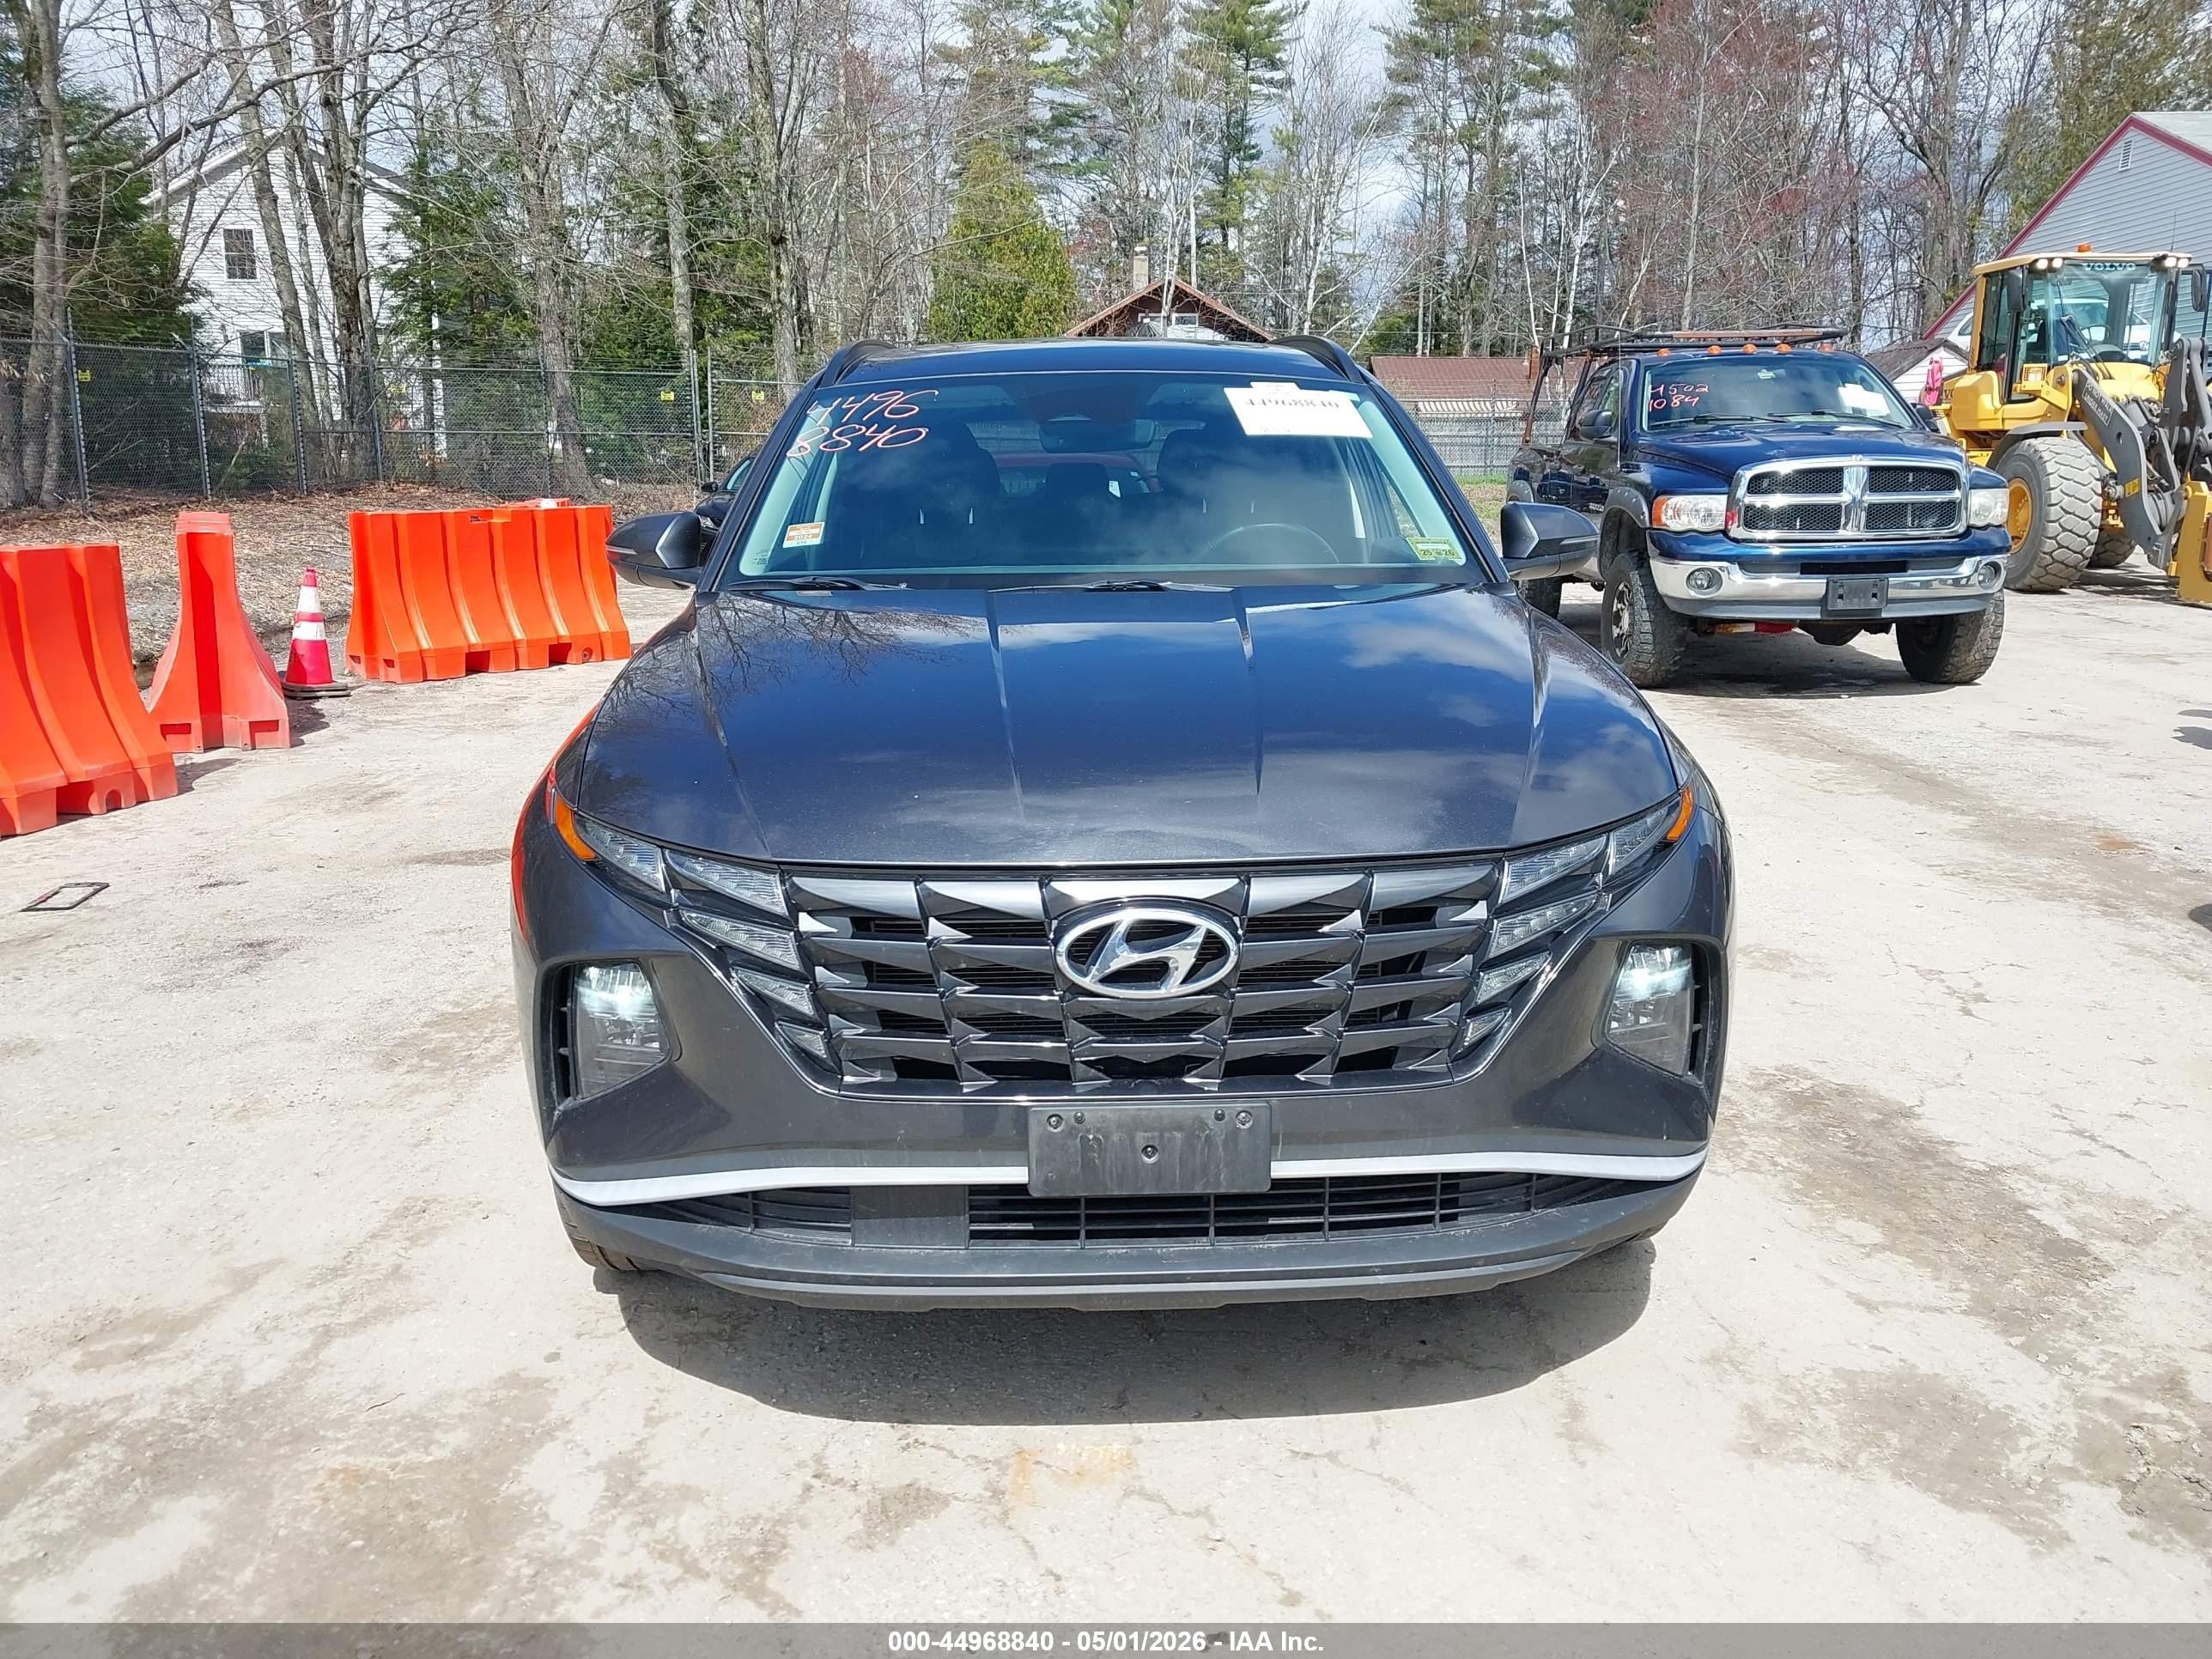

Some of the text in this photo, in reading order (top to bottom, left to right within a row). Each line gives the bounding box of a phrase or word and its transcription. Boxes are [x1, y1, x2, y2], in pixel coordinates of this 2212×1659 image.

[2081, 262, 2137, 271] VOLVO
[805, 389, 939, 425] 4496
[1649, 394, 1699, 412] 1084
[786, 423, 930, 458] 8840
